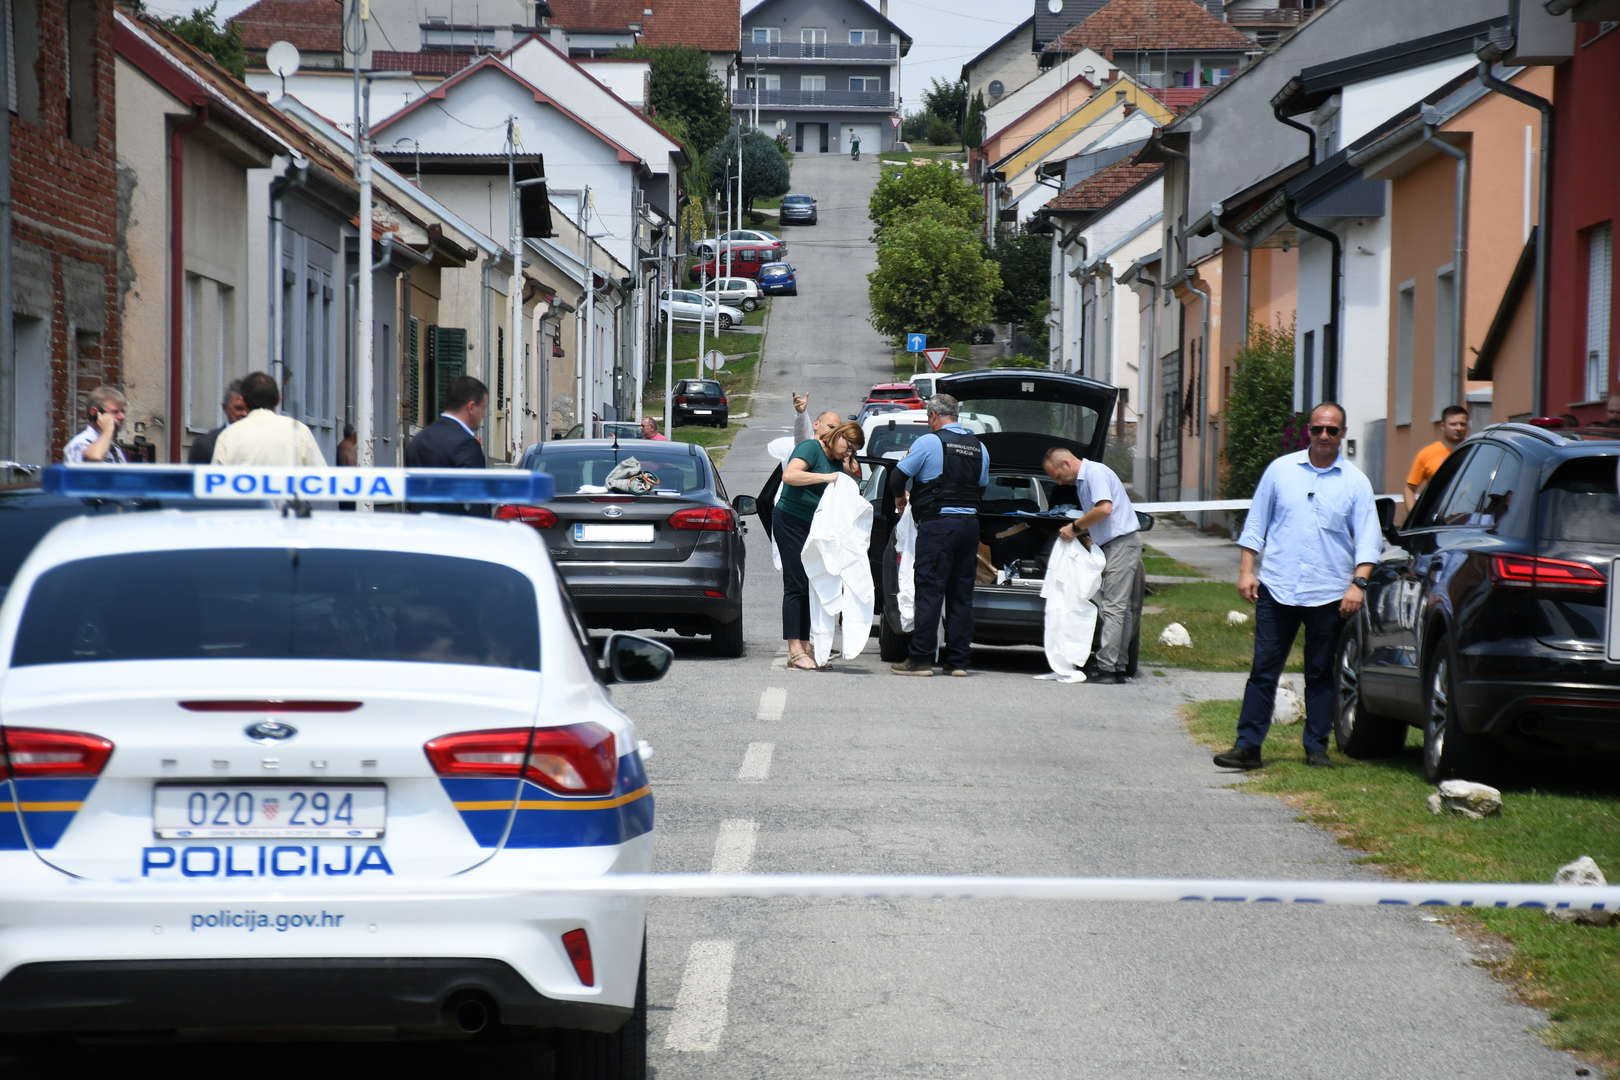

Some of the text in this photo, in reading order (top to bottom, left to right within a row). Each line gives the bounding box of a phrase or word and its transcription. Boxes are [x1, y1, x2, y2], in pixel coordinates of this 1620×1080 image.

[204, 474, 393, 496] POLICIJA
[188, 792, 353, 826] 020 294
[141, 846, 394, 877] POLICIJA
[191, 909, 344, 932] policija.gov.hr
